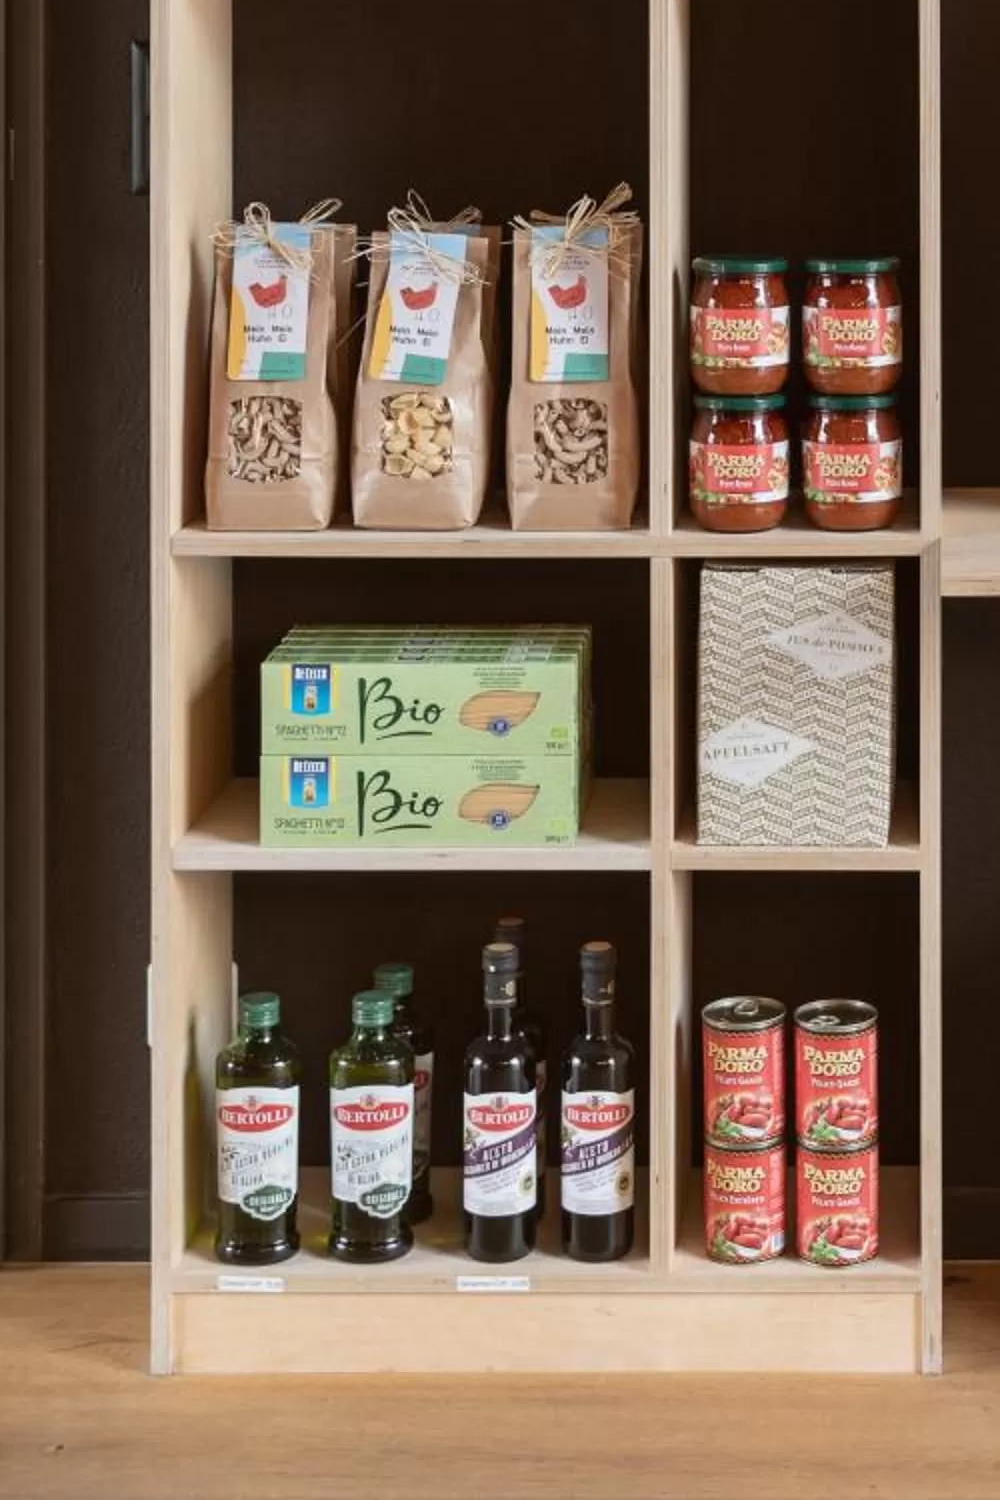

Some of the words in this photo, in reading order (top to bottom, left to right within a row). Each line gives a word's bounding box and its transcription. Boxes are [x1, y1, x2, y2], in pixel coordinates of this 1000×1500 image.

[706, 315, 765, 331] PARMA
[821, 316, 880, 331] PARMA
[712, 329, 759, 341] DORO
[829, 330, 876, 342] DORO
[707, 451, 765, 467] PARMA
[815, 451, 873, 465] PARMA
[714, 465, 761, 478] DORO
[821, 464, 867, 477] DORO
[358, 677, 445, 744] Bio
[356, 770, 443, 837] Bio
[707, 1041, 769, 1061] PARMA
[803, 1045, 865, 1062] PARMA
[714, 1059, 764, 1073] DORO
[810, 1061, 861, 1076] DORO
[222, 1107, 288, 1125] BERTOLLI
[337, 1105, 405, 1123] BERTOLLI
[470, 1106, 529, 1124] BERTOLLI
[567, 1106, 627, 1123] BERTOLLI
[706, 1158, 766, 1180] PARMA
[803, 1161, 866, 1182] PARMA
[712, 1177, 761, 1193] DORO
[810, 1179, 862, 1195] DORO
